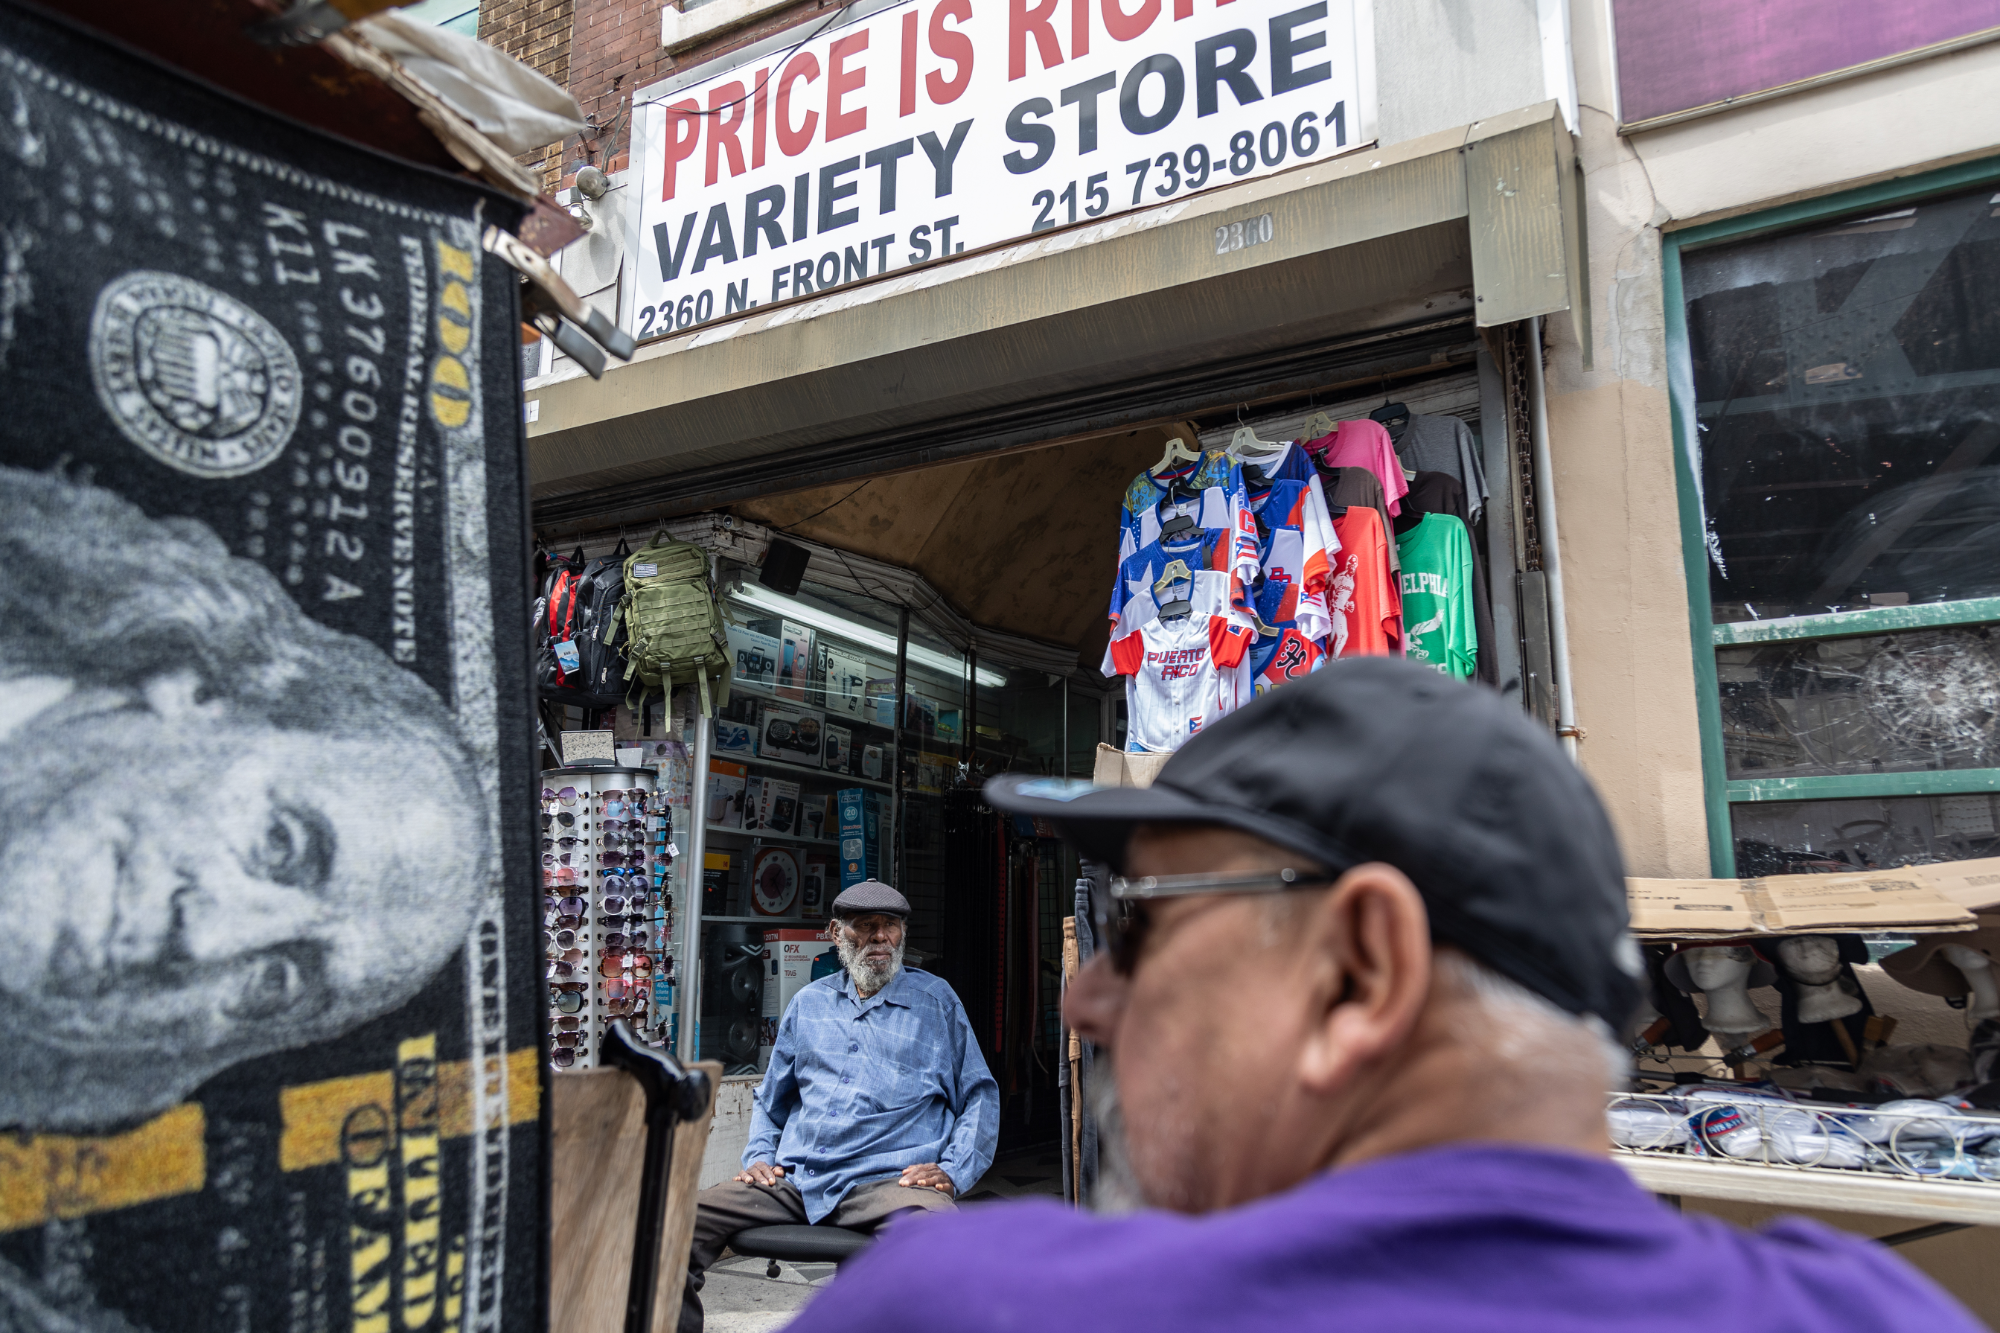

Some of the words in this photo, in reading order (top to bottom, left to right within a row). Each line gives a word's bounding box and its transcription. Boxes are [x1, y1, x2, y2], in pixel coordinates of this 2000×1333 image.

[652, 118, 975, 283] VARIETY
[1003, 0, 1332, 175] STORE
[662, 28, 870, 202] PRICE
[899, 0, 975, 118] IS
[1007, 0, 1237, 82] RI
[1031, 171, 1109, 232] 215
[1125, 101, 1347, 210] 739-8061
[638, 288, 714, 342] 2360
[724, 284, 756, 314] N.
[771, 234, 895, 301] FRONT
[908, 215, 964, 263] ST.
[1215, 213, 1273, 254] 2360
[399, 235, 427, 387] FEDERAL
[393, 392, 420, 560] RESERVE
[393, 565, 417, 662] NOTE
[1401, 572, 1448, 598] ELPHIA
[1147, 648, 1206, 666] PUERTO
[1161, 663, 1199, 680] RICO
